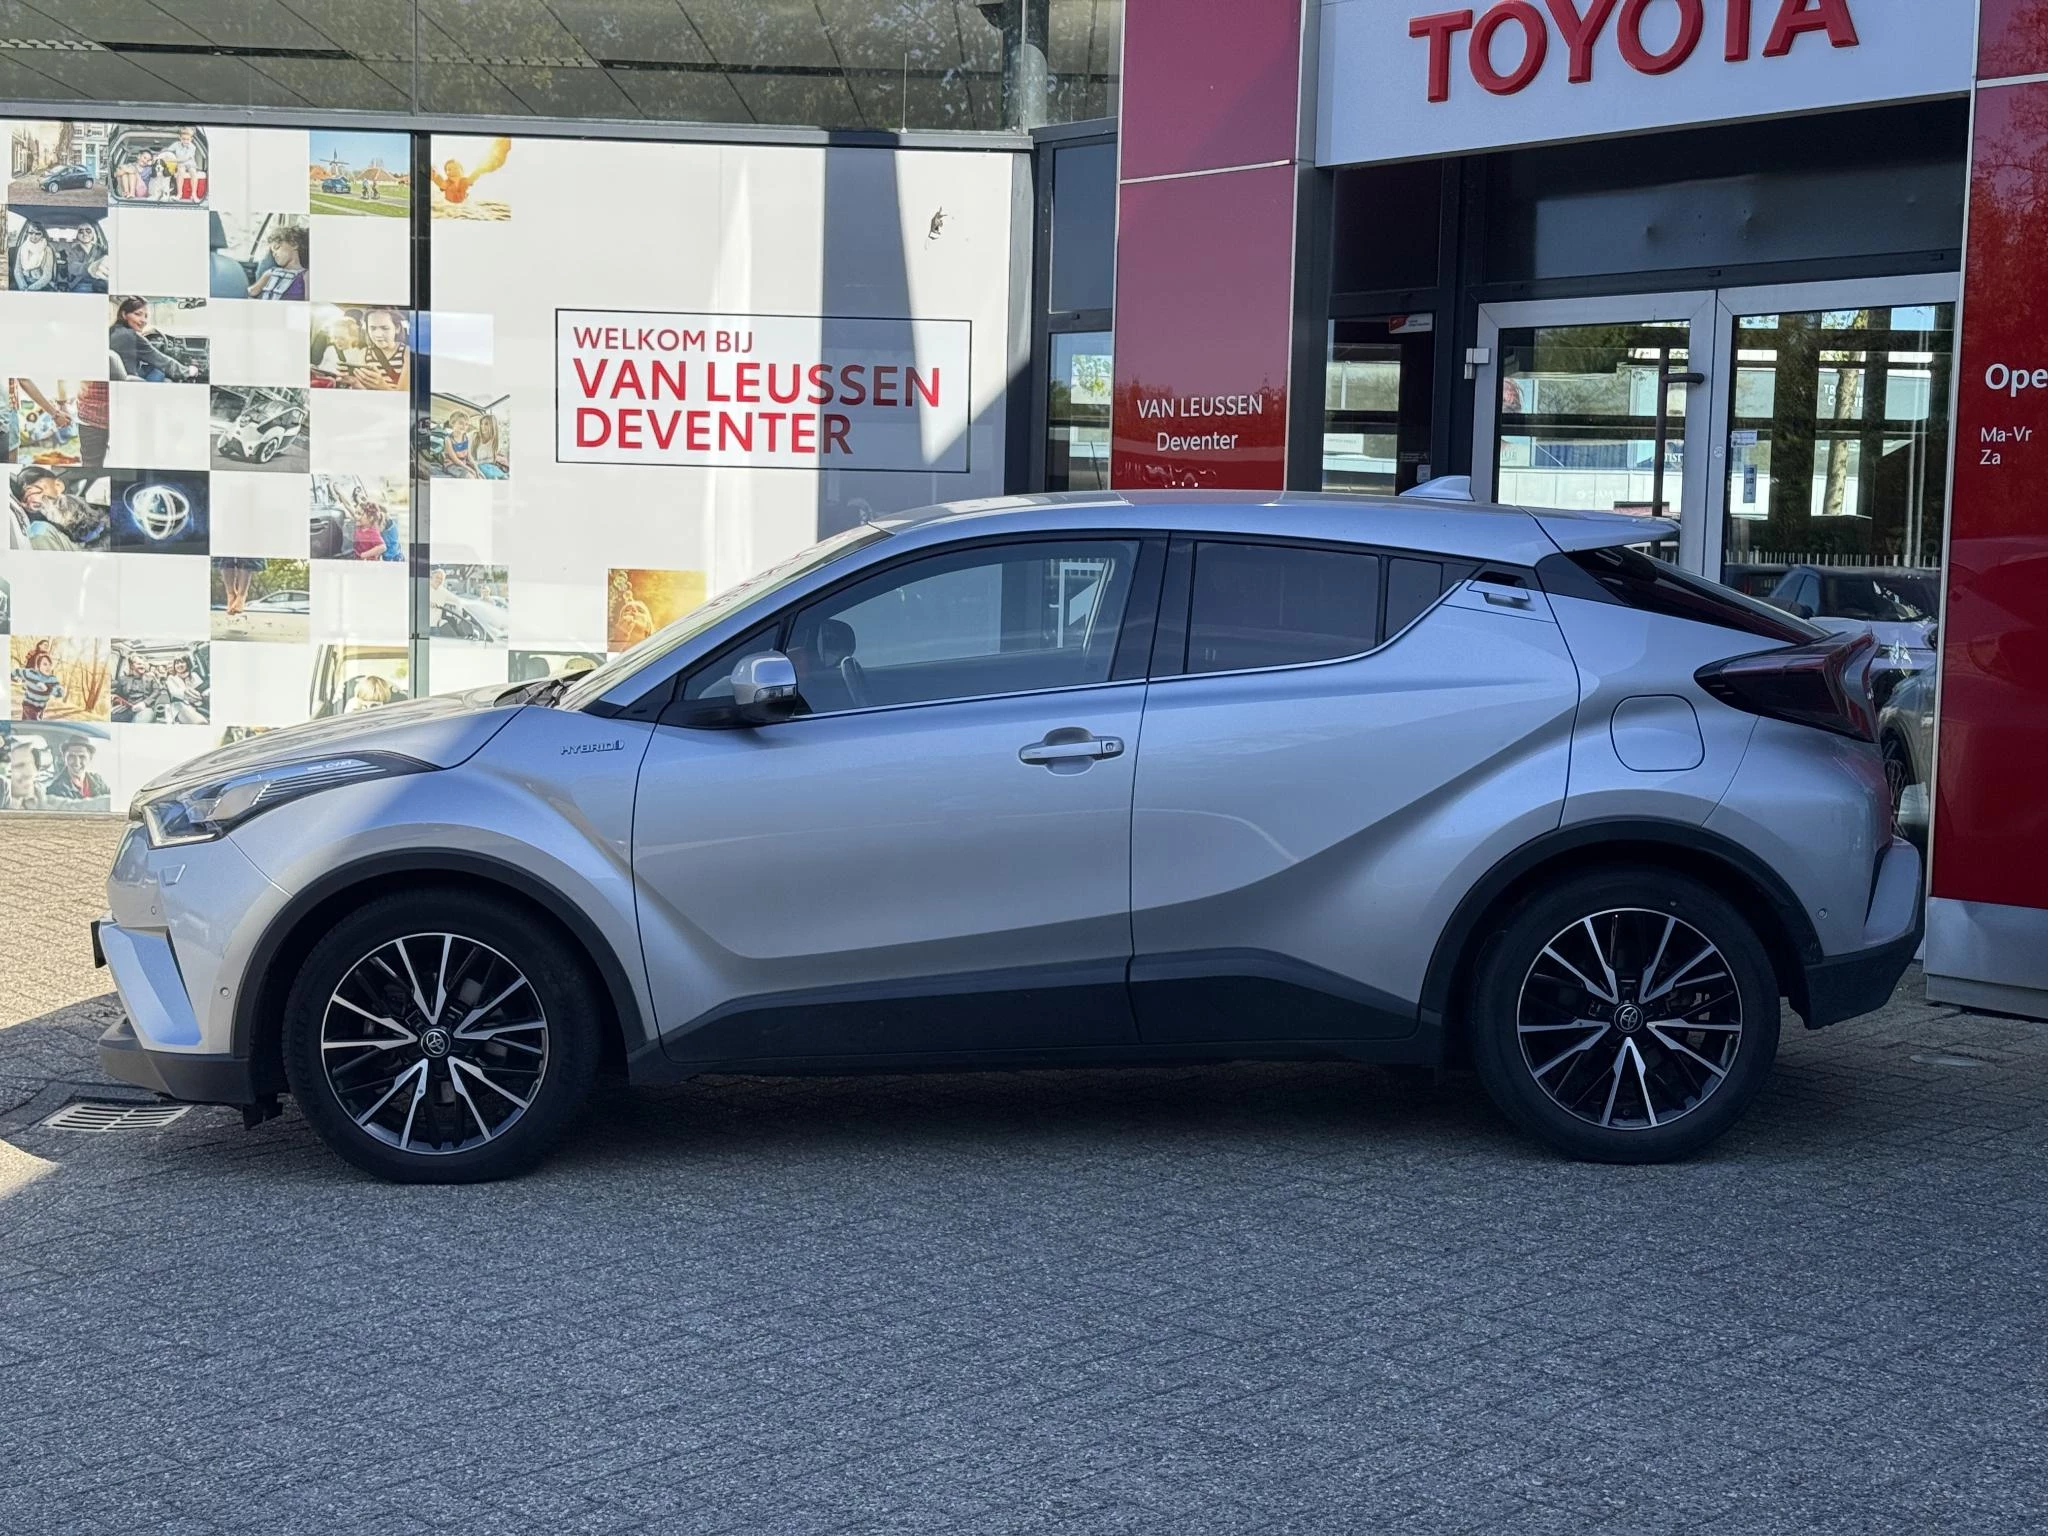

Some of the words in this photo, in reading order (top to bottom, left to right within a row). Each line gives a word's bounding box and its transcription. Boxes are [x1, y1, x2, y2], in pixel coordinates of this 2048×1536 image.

[573, 326, 705, 352] WELKOM
[715, 331, 753, 354] BIJ
[573, 358, 686, 401] VAN
[707, 362, 940, 407] LEUSSEN
[1137, 398, 1175, 419] VAN
[1180, 394, 1263, 418] LEUSSEN
[575, 407, 853, 455] DEVENTER
[1157, 431, 1239, 452] Deventer
[1980, 426, 2032, 442] Ma-Vr
[1979, 449, 2001, 465] Za
